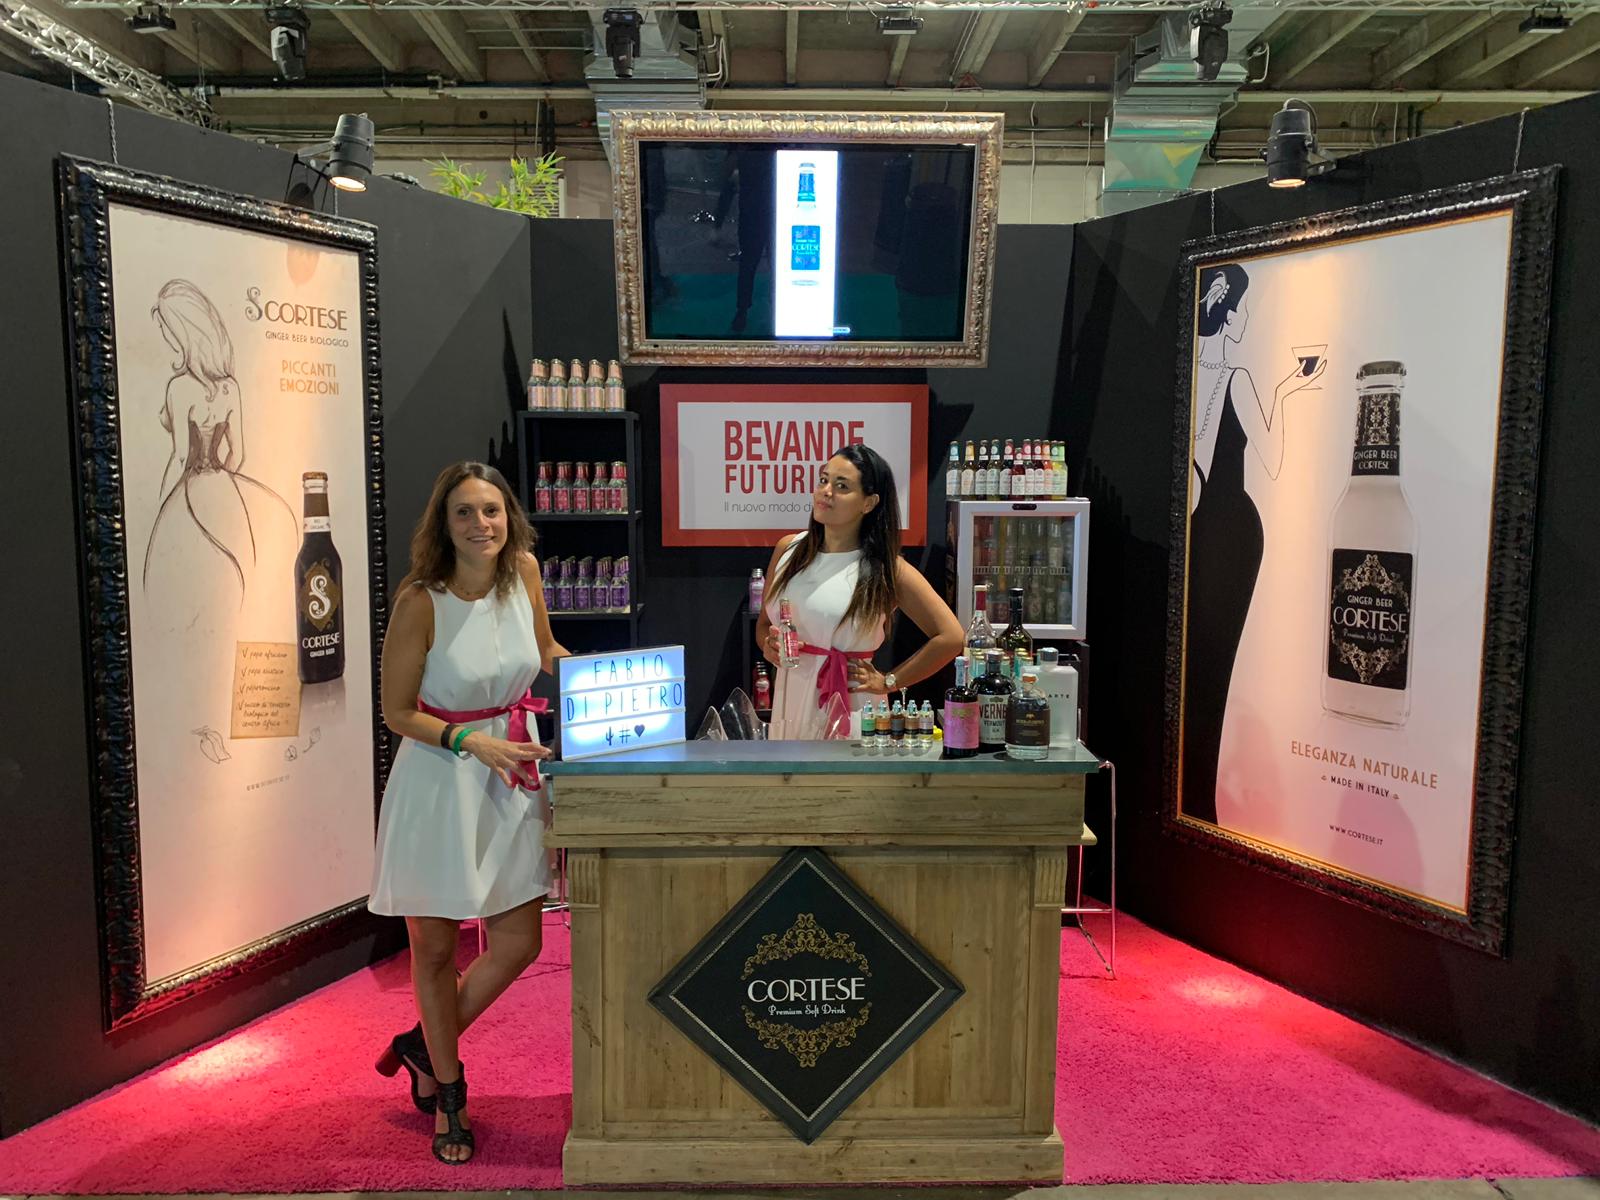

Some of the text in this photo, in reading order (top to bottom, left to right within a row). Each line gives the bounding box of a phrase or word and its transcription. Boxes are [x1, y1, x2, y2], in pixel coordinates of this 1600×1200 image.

[265, 331, 349, 347] GINGER BEER BIOLOGICO
[282, 360, 336, 377] PICCANTI
[280, 378, 339, 395] EMOZIONI
[724, 421, 864, 461] BEVANDE
[1353, 450, 1397, 460] GINGER BEER
[725, 464, 828, 494] FUTURI
[732, 504, 766, 512] nuovo
[769, 501, 800, 513] modo
[1347, 594, 1393, 608] GINGER BEER
[1333, 606, 1407, 634] CORTESE
[302, 632, 340, 649] CORTESE
[594, 654, 664, 684] FABIO
[567, 683, 682, 721] DI PIETRO
[1291, 740, 1438, 789] ELEGANZA NATURALE
[1330, 776, 1389, 798] MADE IN ITALY
[747, 977, 865, 1003] CORTESE
[768, 1003, 846, 1018] Premium Soft Drink
